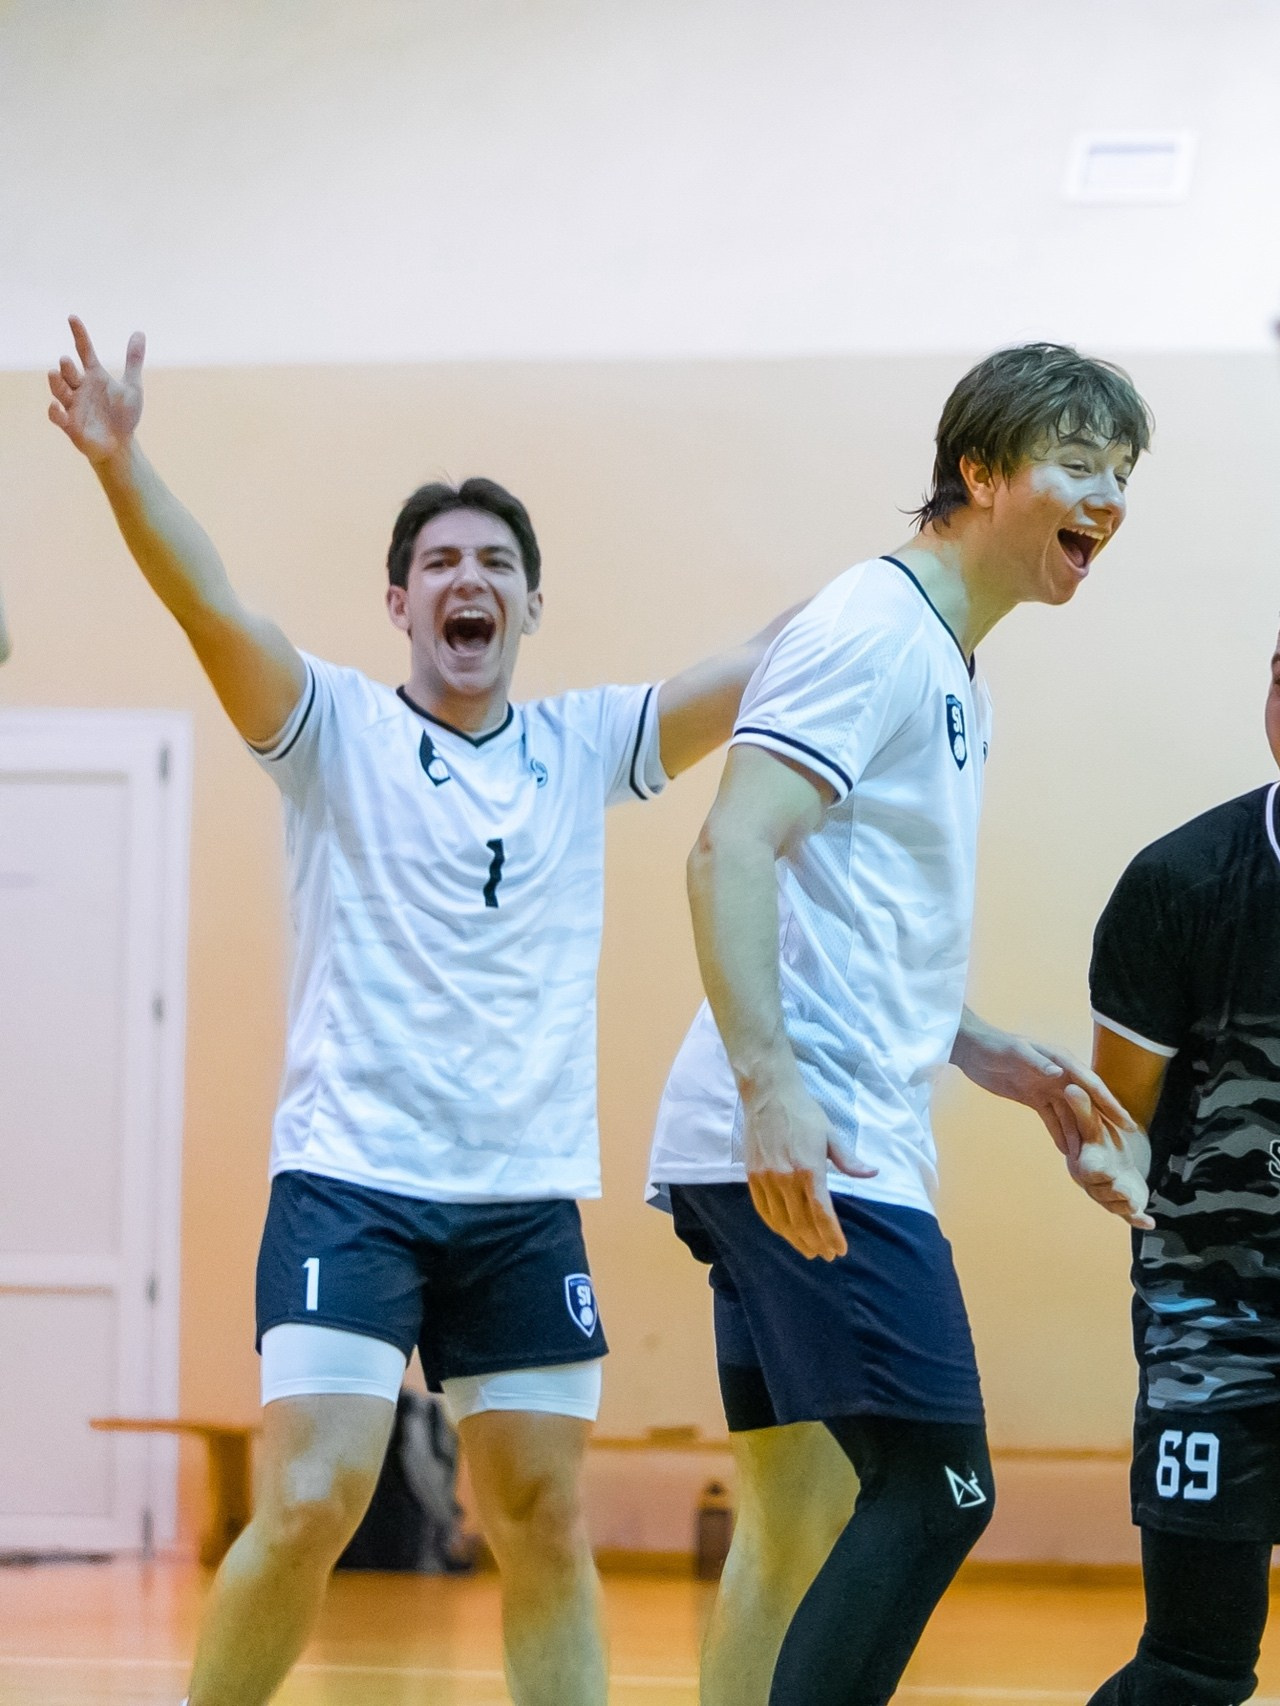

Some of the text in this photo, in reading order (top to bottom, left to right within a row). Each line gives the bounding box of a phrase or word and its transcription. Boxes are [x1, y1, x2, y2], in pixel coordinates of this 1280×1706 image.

[483, 837, 506, 908] 1
[302, 1257, 320, 1311] 1
[1156, 1429, 1220, 1500] 69
